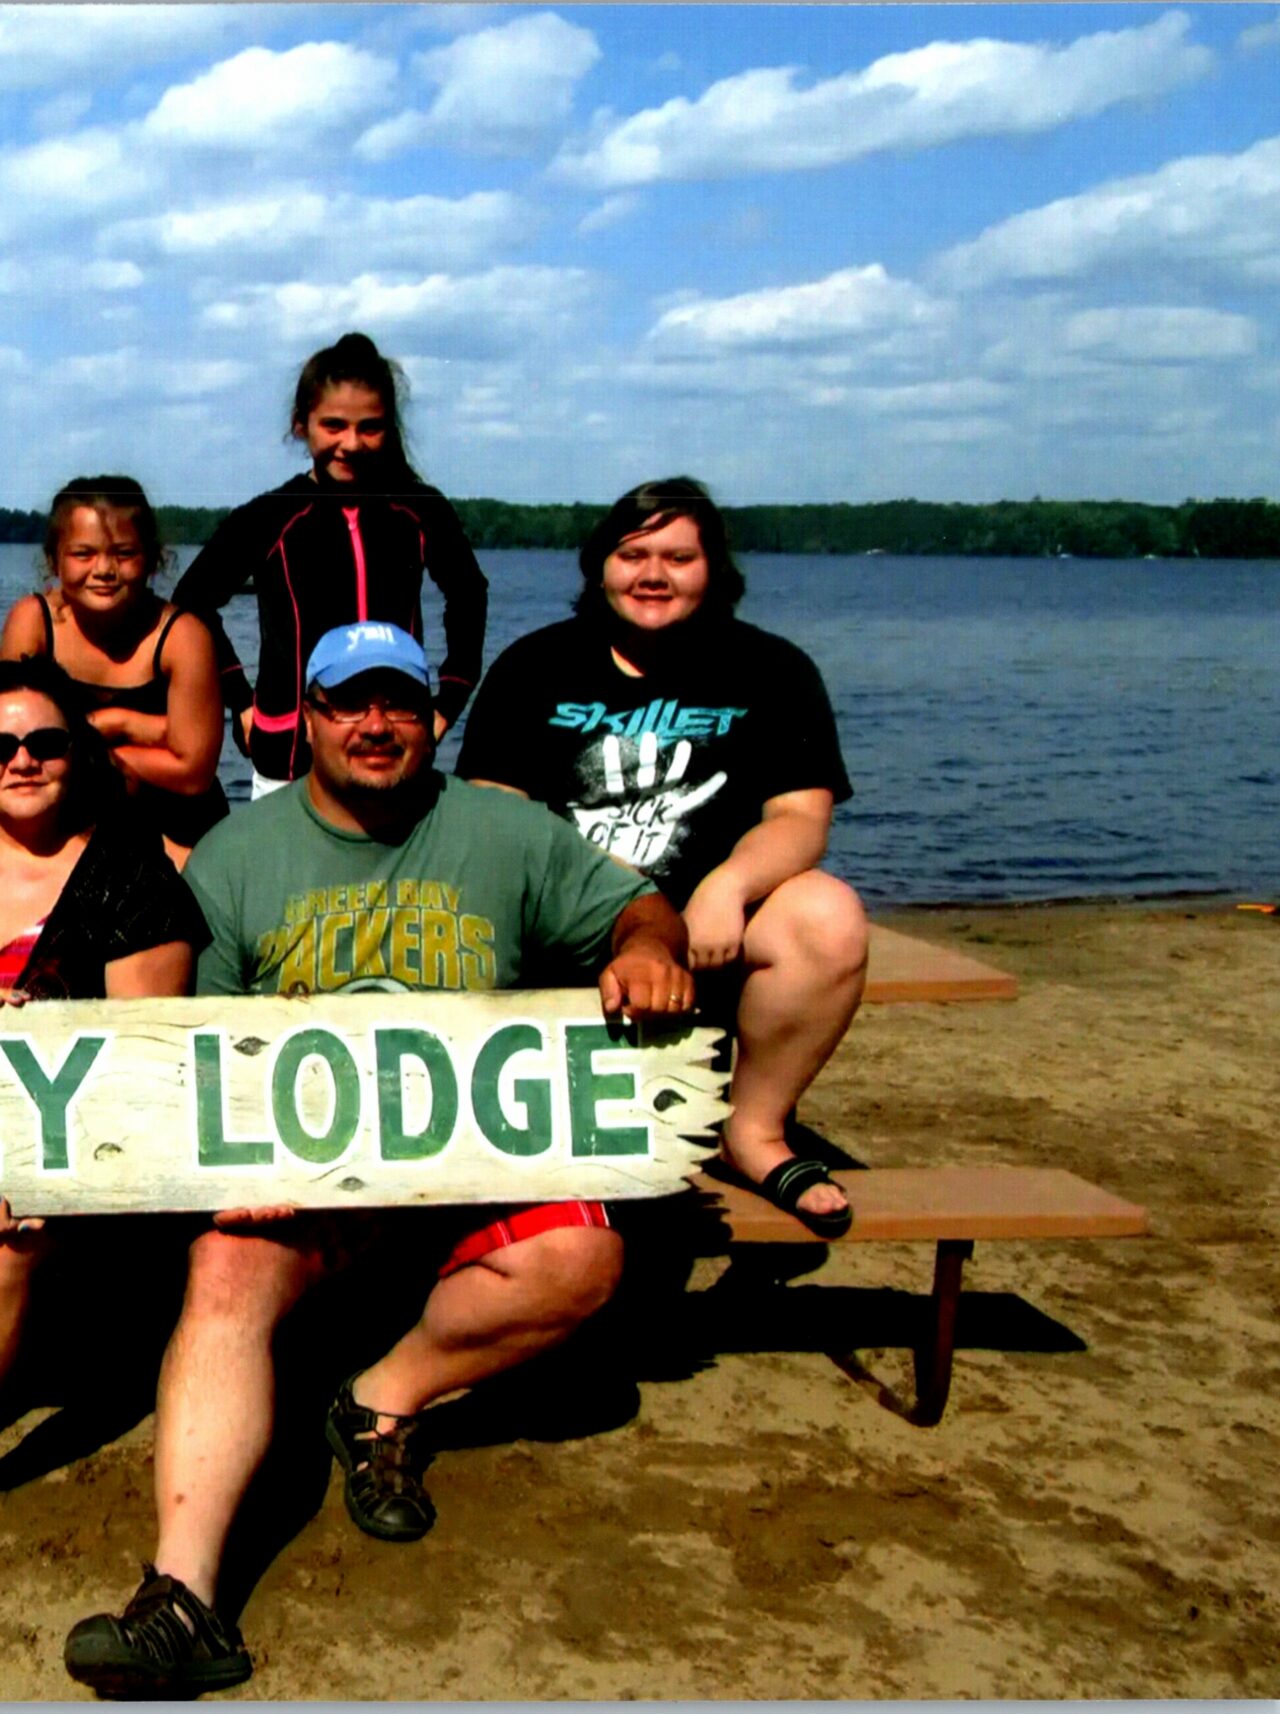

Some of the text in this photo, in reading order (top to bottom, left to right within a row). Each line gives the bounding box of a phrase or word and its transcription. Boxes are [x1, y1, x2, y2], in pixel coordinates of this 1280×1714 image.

[608, 797, 672, 827] SICK
[586, 821, 665, 861] OF IT
[285, 878, 462, 923] GREEN BAY
[254, 906, 497, 992] PACKERS
[189, 1019, 656, 1169] LODGE
